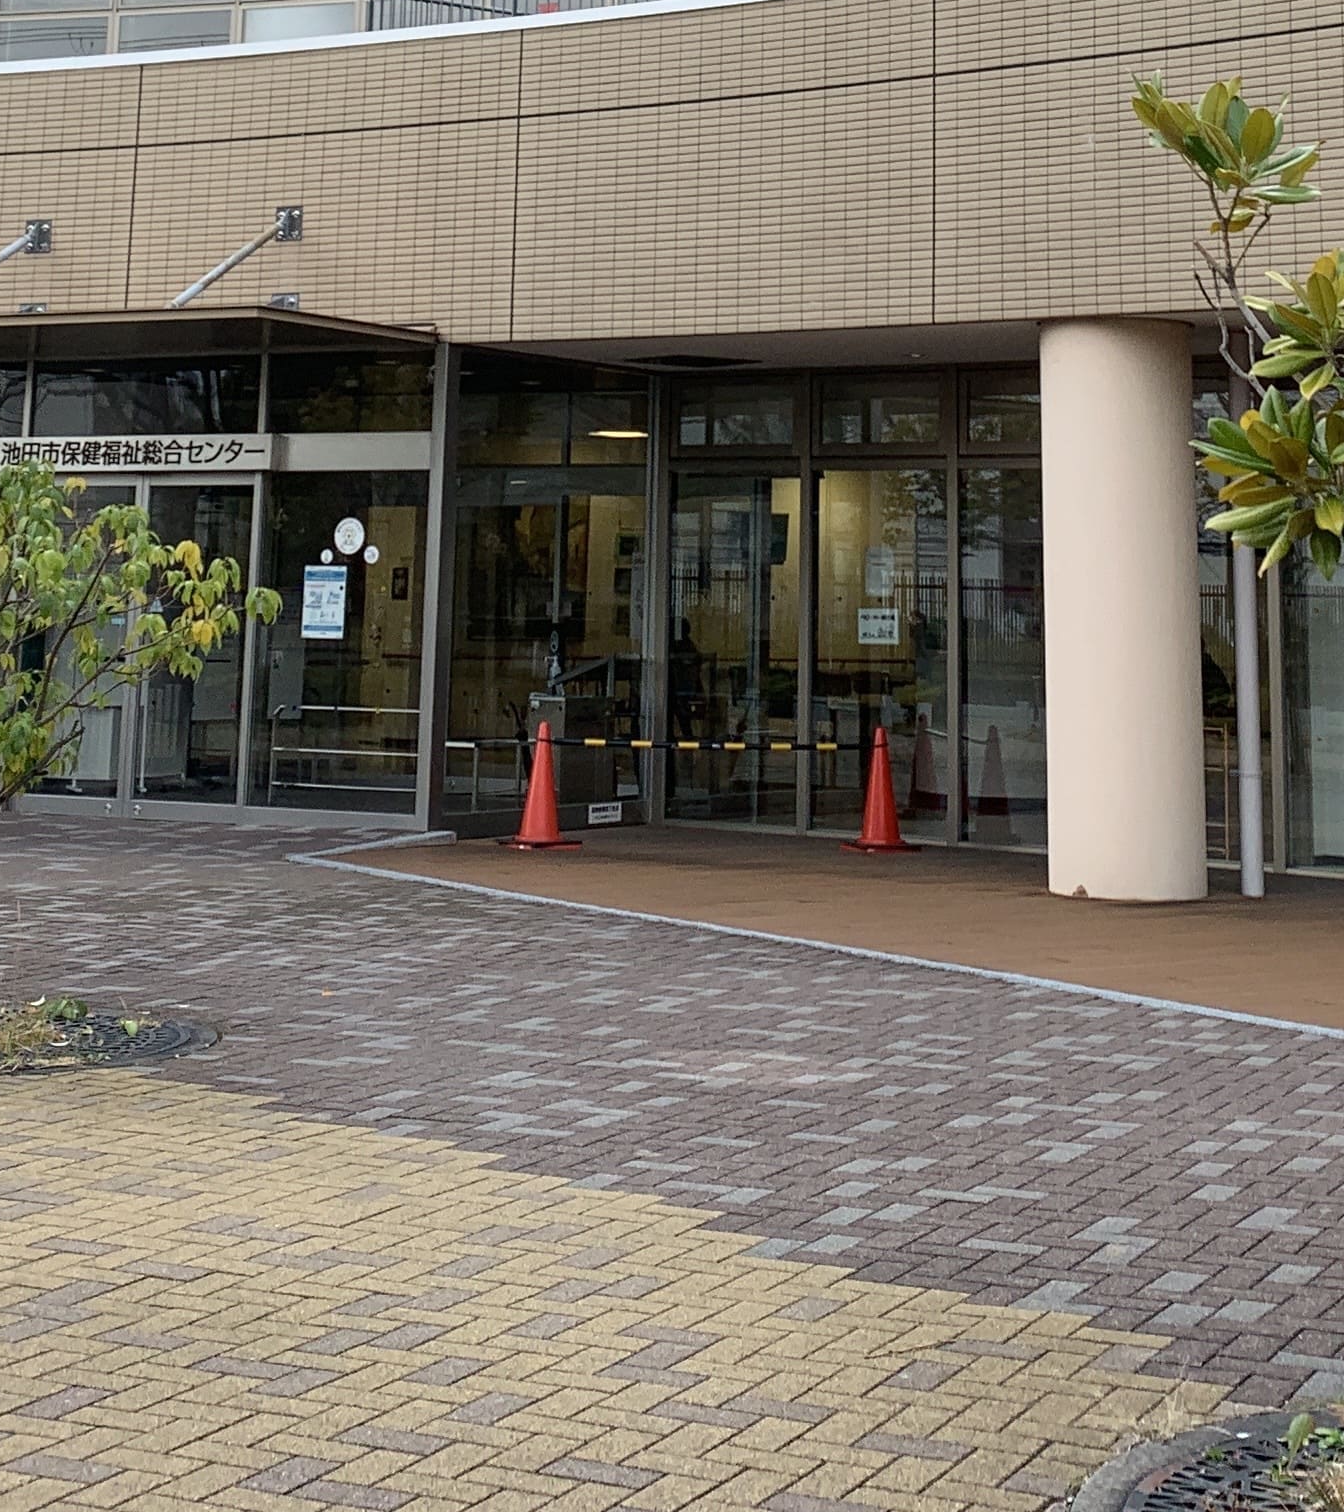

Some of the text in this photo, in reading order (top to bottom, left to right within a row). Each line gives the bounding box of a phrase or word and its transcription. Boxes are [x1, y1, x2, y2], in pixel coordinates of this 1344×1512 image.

[0, 439, 265, 466] 池田市保健福祉総合センター
